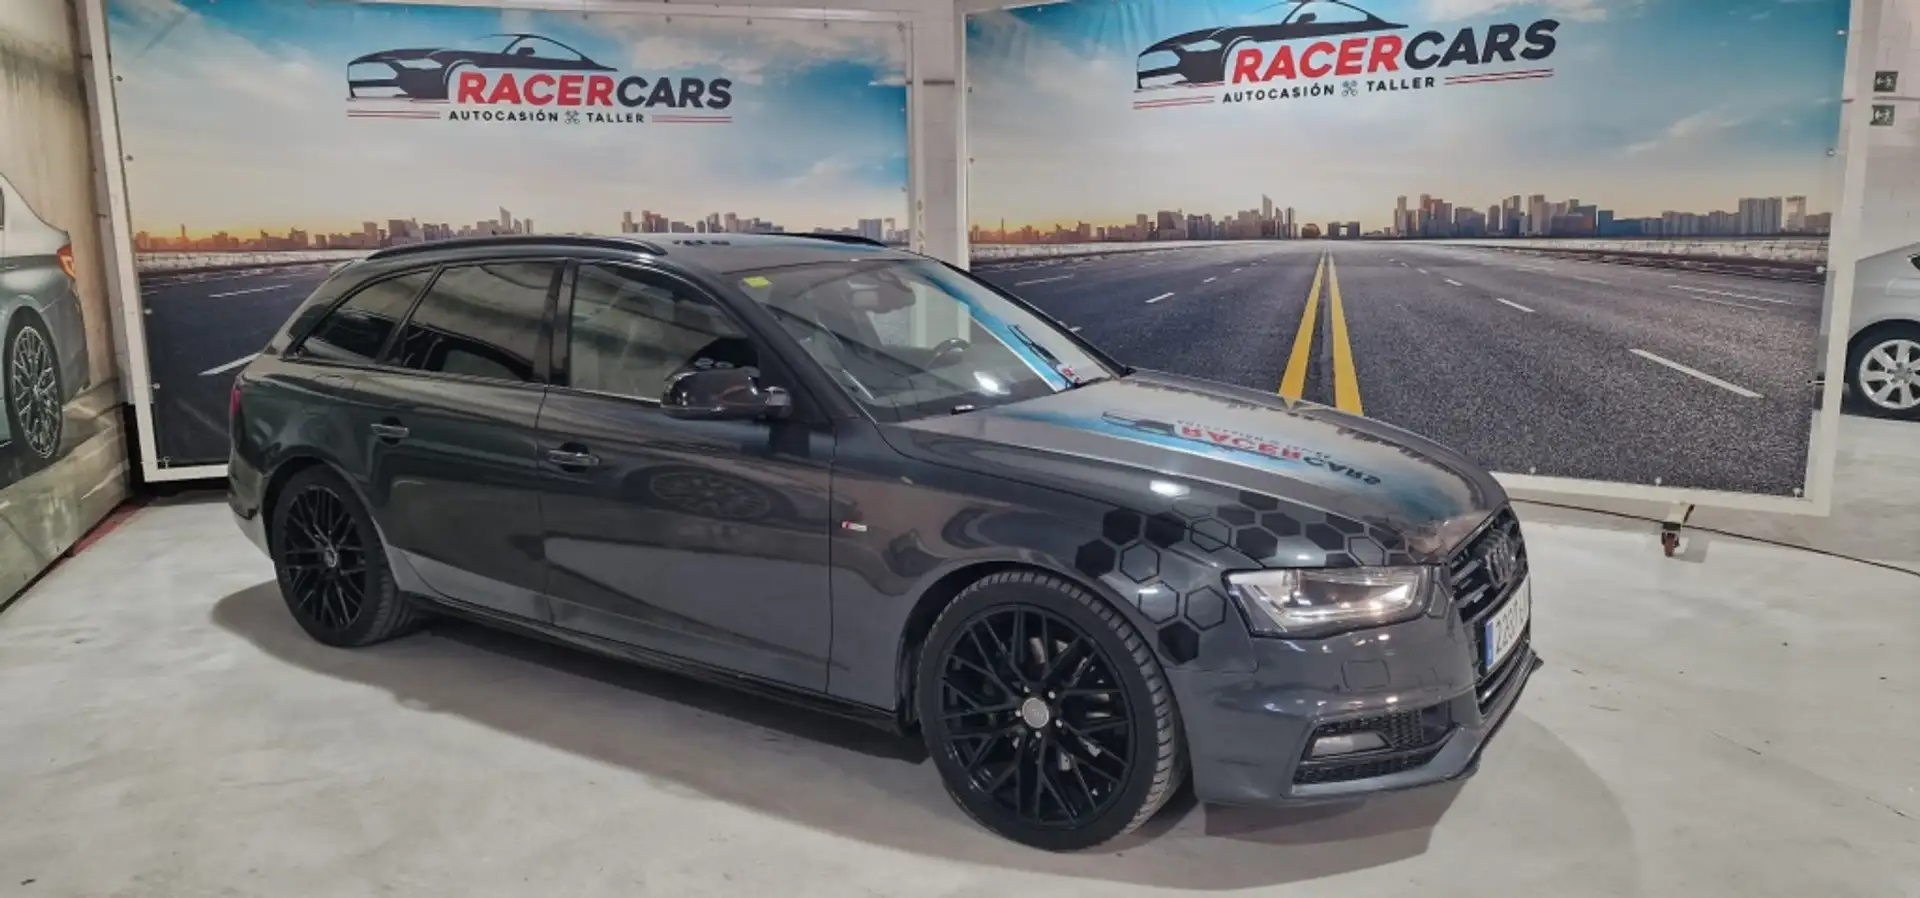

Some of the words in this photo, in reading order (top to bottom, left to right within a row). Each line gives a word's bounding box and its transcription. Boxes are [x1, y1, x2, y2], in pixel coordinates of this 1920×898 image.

[1232, 19, 1559, 83] RACERCARS
[457, 71, 732, 109] RACERCARS
[1222, 82, 1334, 103] AUTOCASIÓN
[1367, 77, 1436, 92] TALLER
[449, 109, 558, 122] AUTOCASIÓN
[587, 112, 645, 123] TALLER
